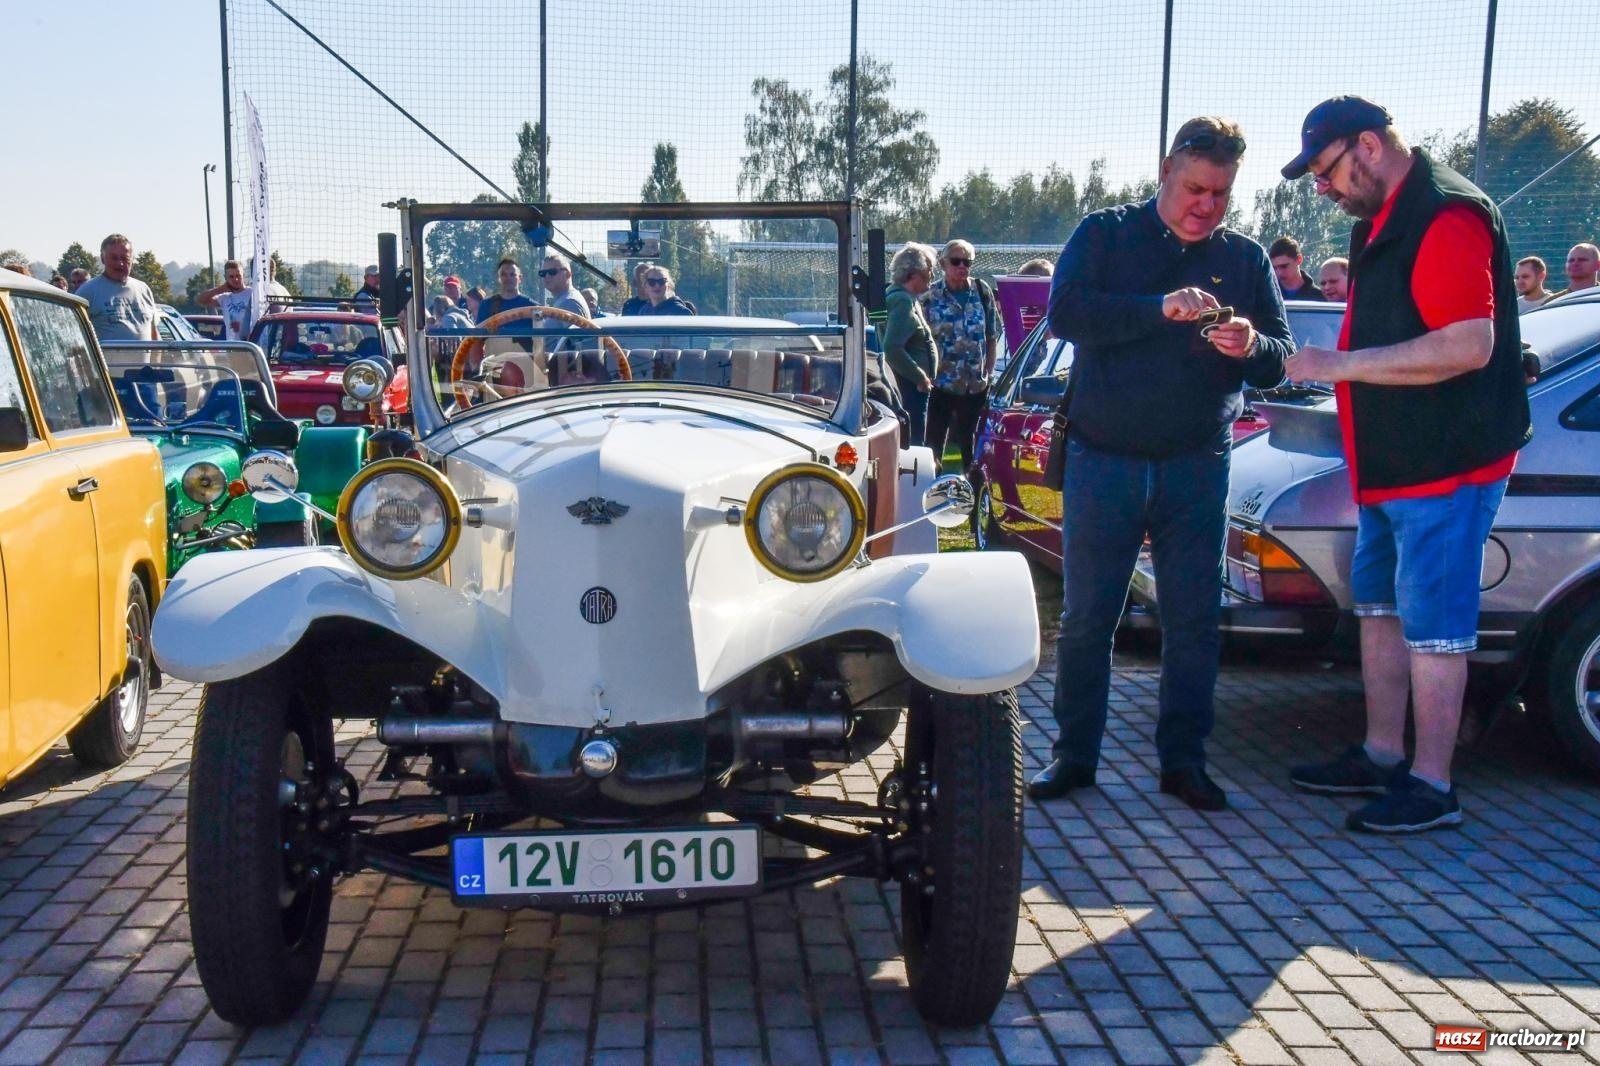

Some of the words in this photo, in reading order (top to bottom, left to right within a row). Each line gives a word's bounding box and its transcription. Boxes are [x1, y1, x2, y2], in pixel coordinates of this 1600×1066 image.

[582, 590, 613, 622] TATRA
[498, 841, 580, 887] 12V
[624, 836, 735, 884] 1610
[460, 875, 481, 888] CZ
